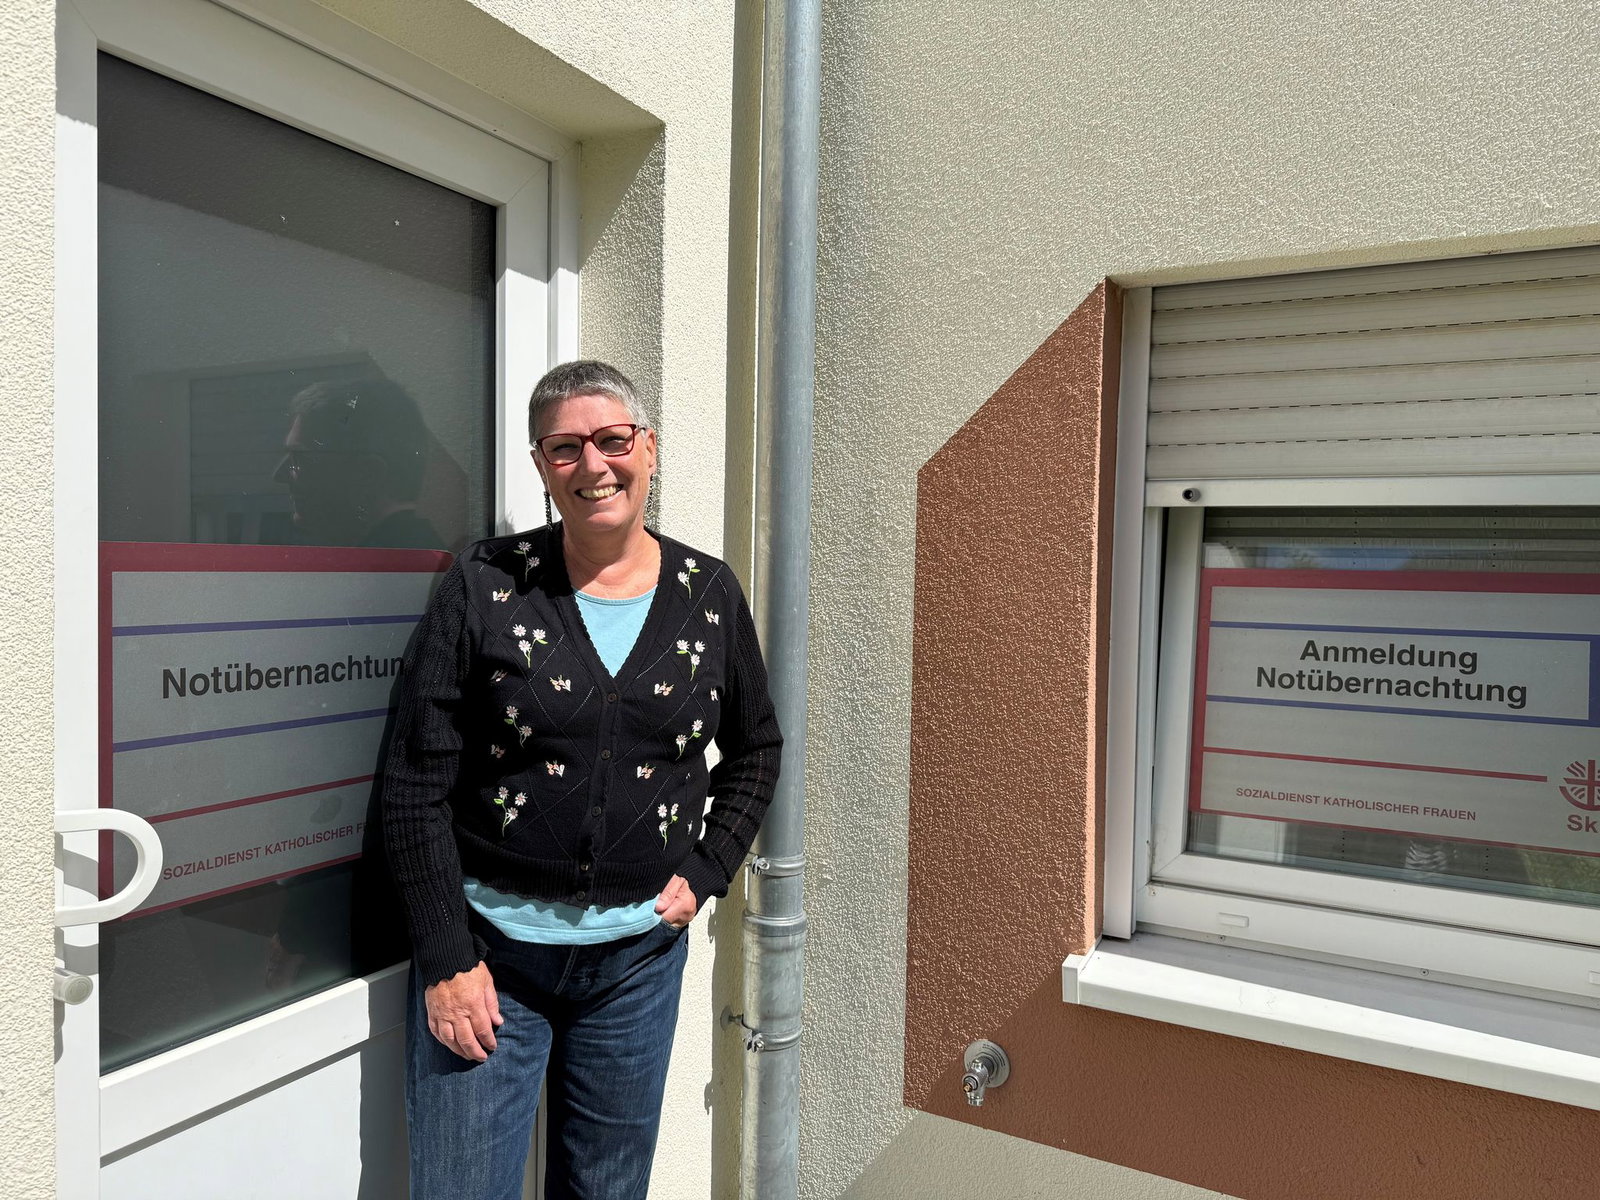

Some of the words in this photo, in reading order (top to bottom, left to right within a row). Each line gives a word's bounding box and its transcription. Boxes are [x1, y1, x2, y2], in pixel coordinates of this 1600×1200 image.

[1300, 640, 1478, 674] Anmeldung
[1256, 667, 1527, 709] Notübernachtung
[1236, 788, 1320, 805] SOZIALDIENST
[1323, 797, 1419, 816] KATHOLISCHER
[1423, 806, 1477, 821] FRAUEN
[163, 847, 261, 880] SOZIALDIENST
[264, 824, 353, 855] KATHOLISCHER
